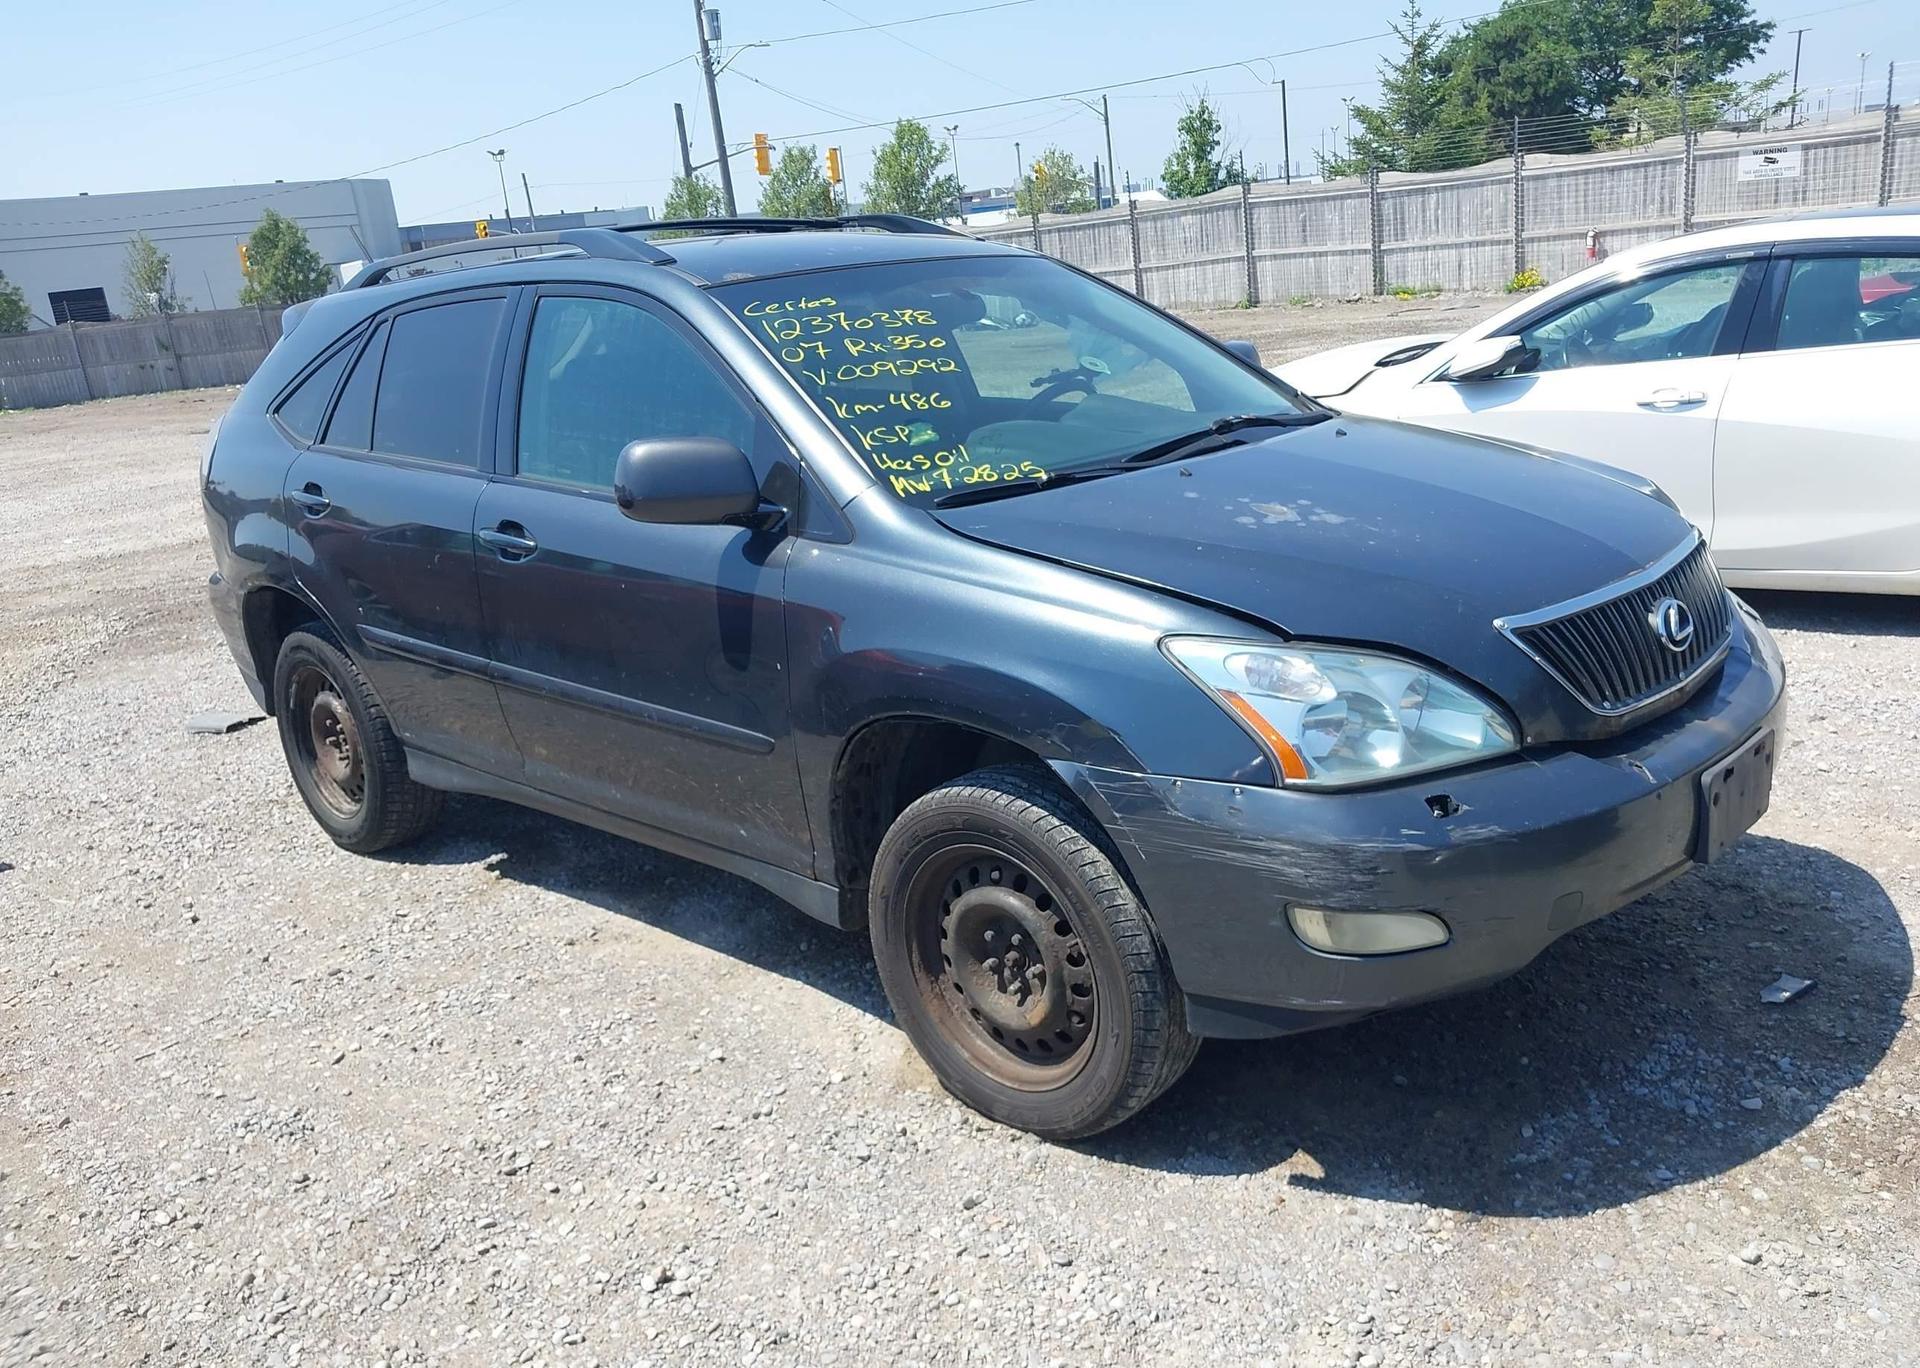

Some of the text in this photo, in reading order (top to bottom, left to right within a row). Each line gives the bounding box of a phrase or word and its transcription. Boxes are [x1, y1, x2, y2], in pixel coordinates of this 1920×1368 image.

[1752, 146, 1788, 155] WARNING
[744, 297, 836, 316] Certas
[762, 310, 937, 344] 12370378
[781, 341, 832, 363] 07
